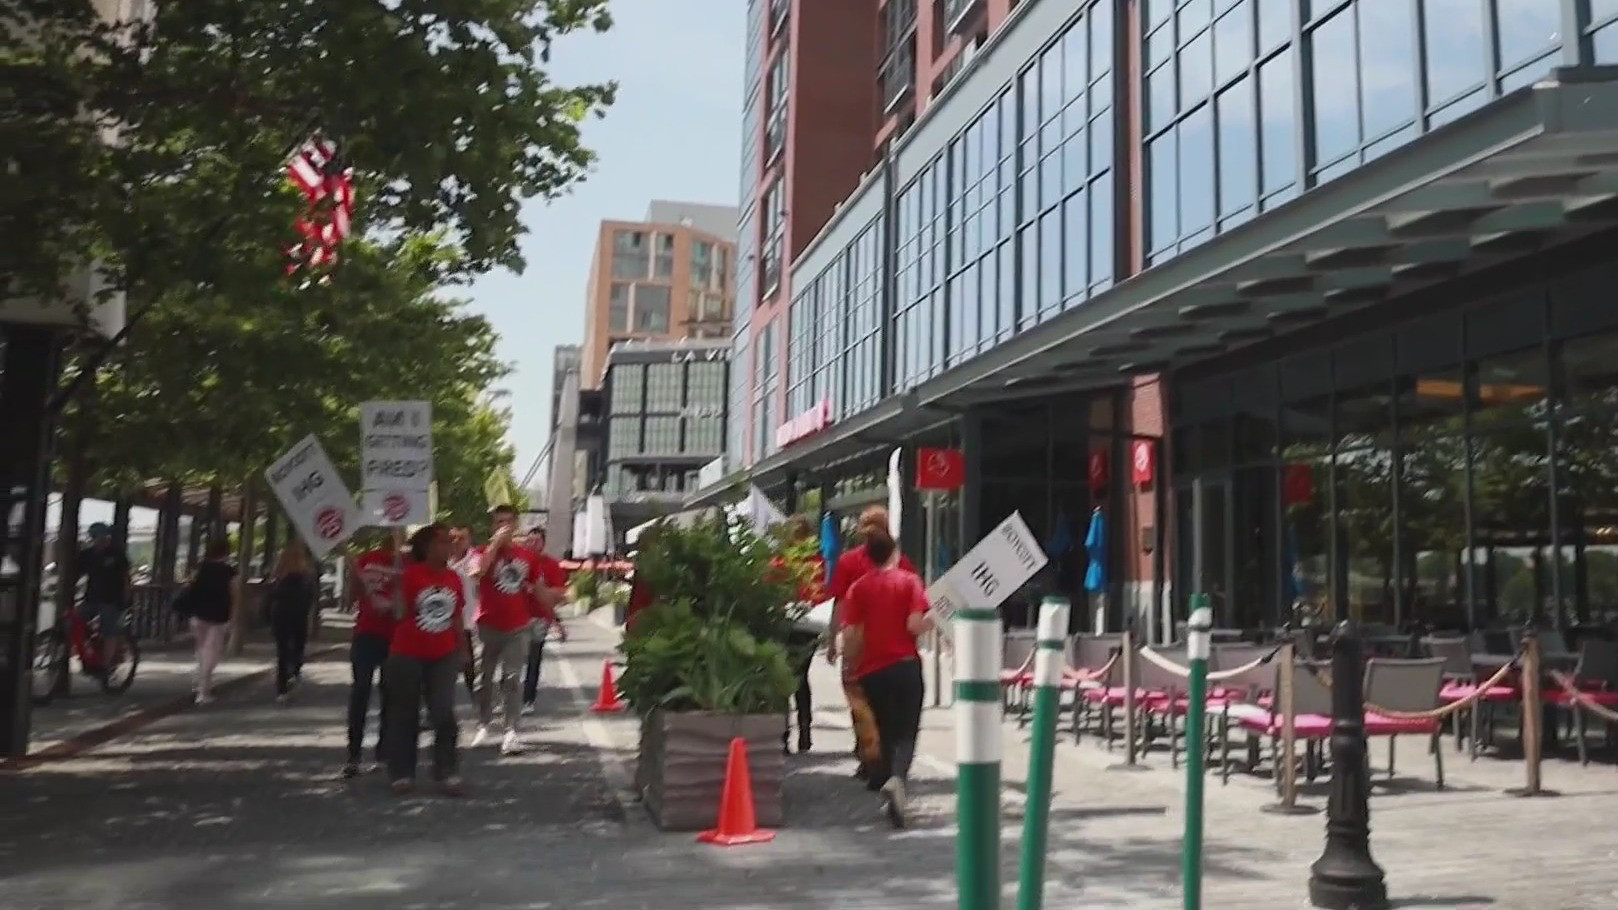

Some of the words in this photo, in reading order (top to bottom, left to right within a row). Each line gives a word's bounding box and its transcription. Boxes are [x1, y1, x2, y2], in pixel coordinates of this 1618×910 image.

[671, 350, 696, 363] LA
[373, 410, 404, 427] AM
[367, 460, 428, 478] FIRED?
[292, 470, 325, 501] IHG
[1001, 523, 1036, 571] BOYCOTT
[971, 561, 1000, 598] IHG
